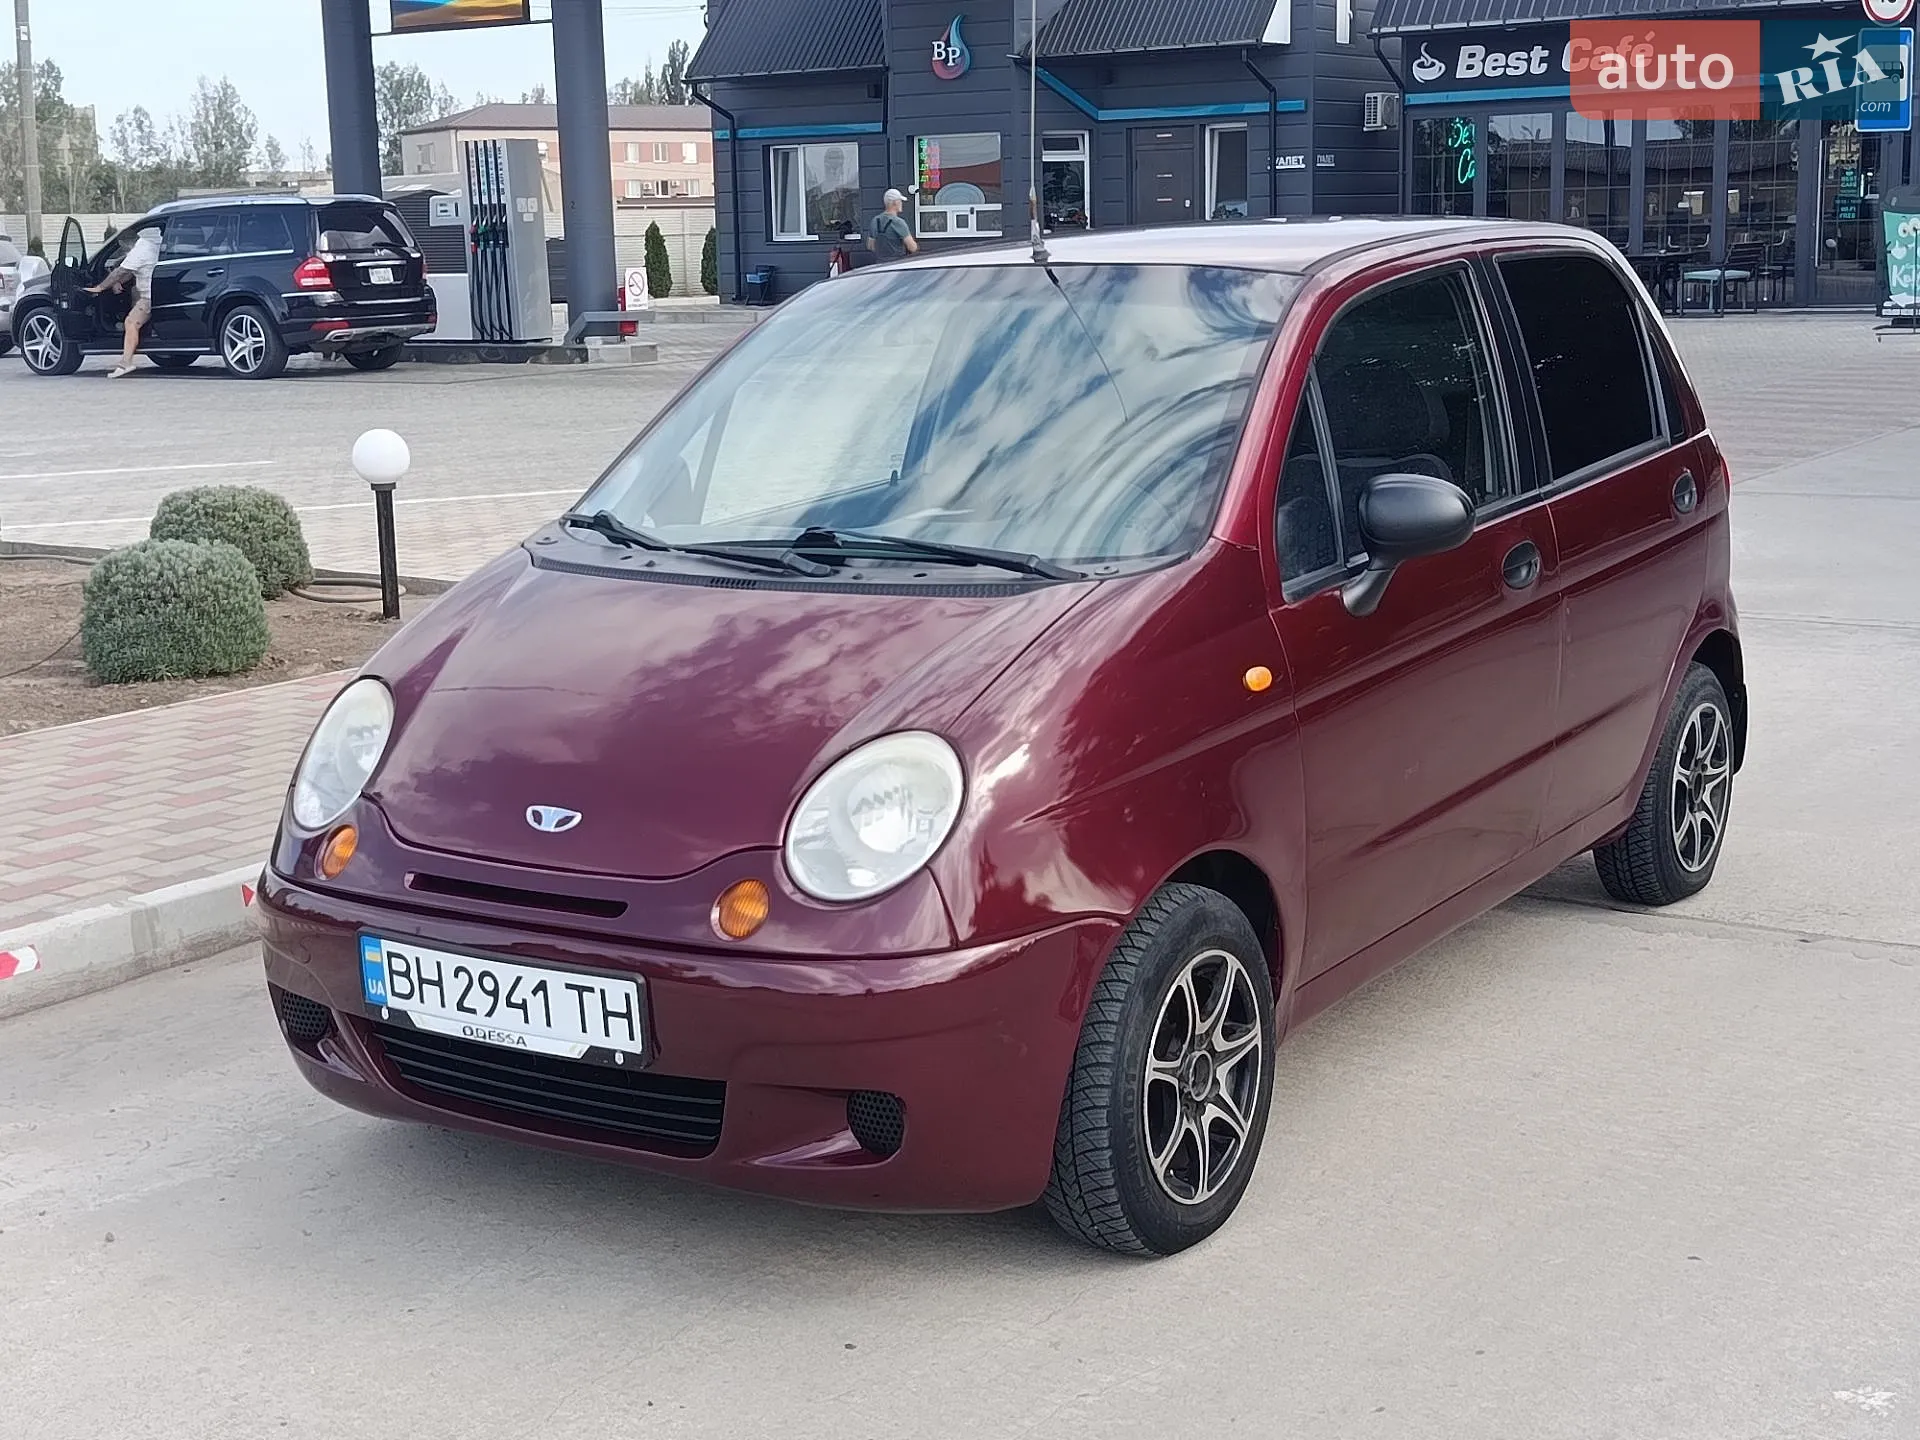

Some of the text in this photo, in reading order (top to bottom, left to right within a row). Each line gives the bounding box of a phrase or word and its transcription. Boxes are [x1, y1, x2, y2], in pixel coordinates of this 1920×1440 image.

[1456, 31, 1656, 79] Best Café
[368, 978, 386, 996] UA
[386, 950, 636, 1042] BH 2941 TH
[462, 1025, 527, 1048] ODESSA
